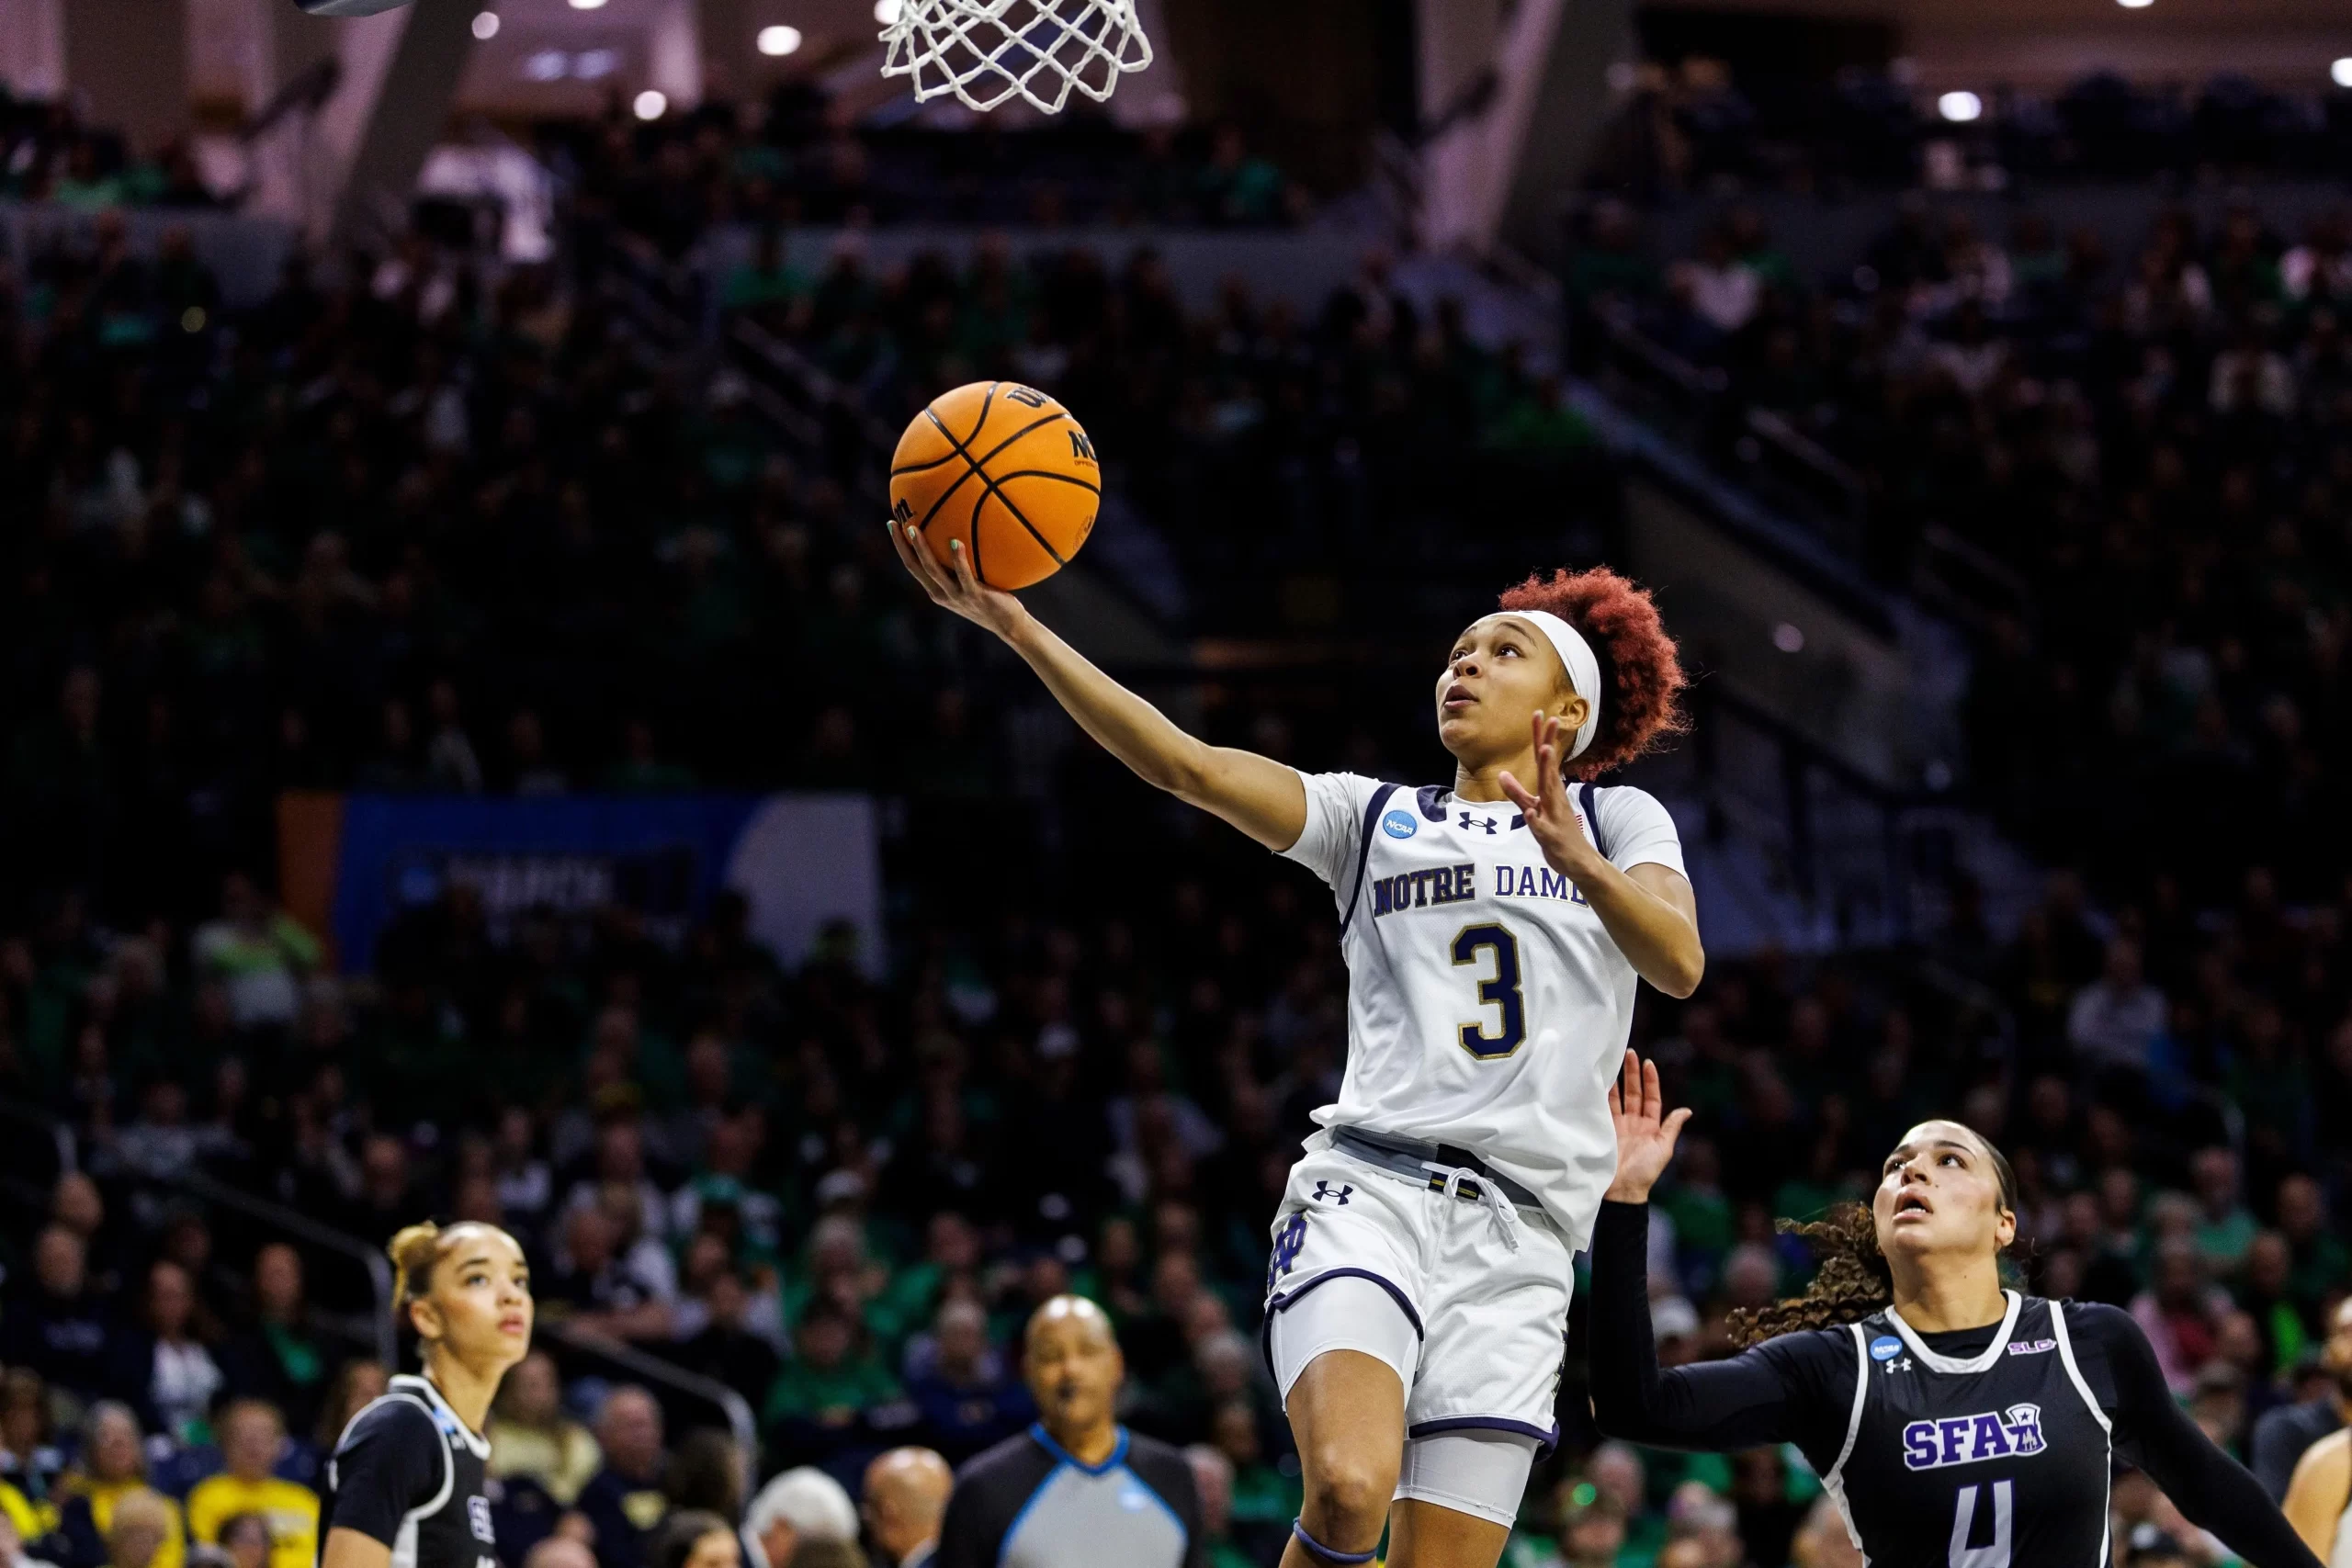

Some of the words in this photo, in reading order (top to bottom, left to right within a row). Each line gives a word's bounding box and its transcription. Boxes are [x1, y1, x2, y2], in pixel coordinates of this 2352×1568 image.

[1386, 819, 1414, 835] NCAA
[1374, 863, 1476, 918] NOTRE
[1449, 921, 1527, 1061] 3
